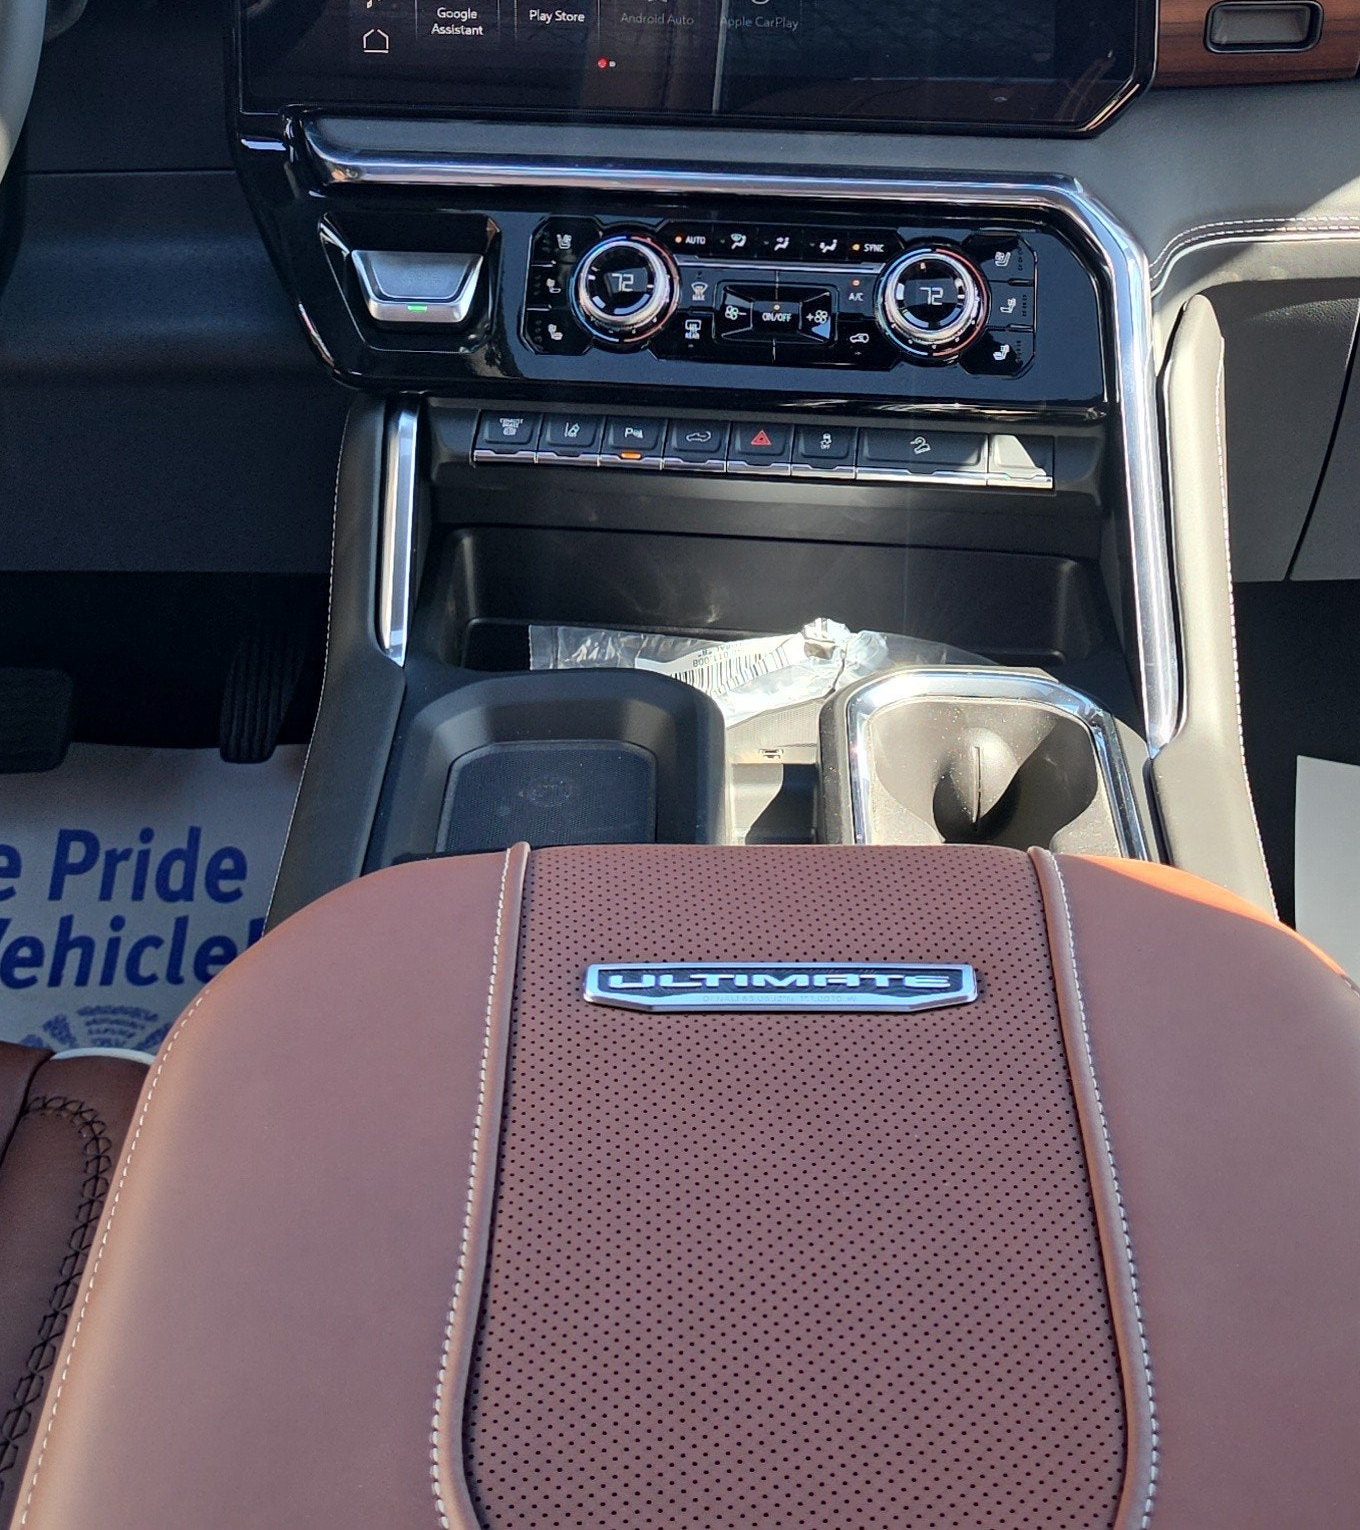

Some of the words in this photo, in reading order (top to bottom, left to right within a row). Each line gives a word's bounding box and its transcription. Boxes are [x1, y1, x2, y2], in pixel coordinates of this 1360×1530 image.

[437, 8, 477, 22] Google
[529, 10, 552, 25] Play
[554, 10, 585, 23] Store
[621, 12, 665, 25] Android
[668, 13, 694, 26] Auto
[431, 23, 483, 36] Assistant
[720, 16, 752, 30] Apple
[755, 16, 799, 30] CarPlay
[685, 236, 706, 245] AUTO
[863, 243, 885, 253] SYNC
[612, 273, 634, 291] 72
[848, 292, 864, 302] A/C
[919, 287, 943, 306] 72
[762, 312, 792, 322] ON/OFF
[47, 825, 248, 904] Pride
[607, 973, 951, 988] ULTIMATE
